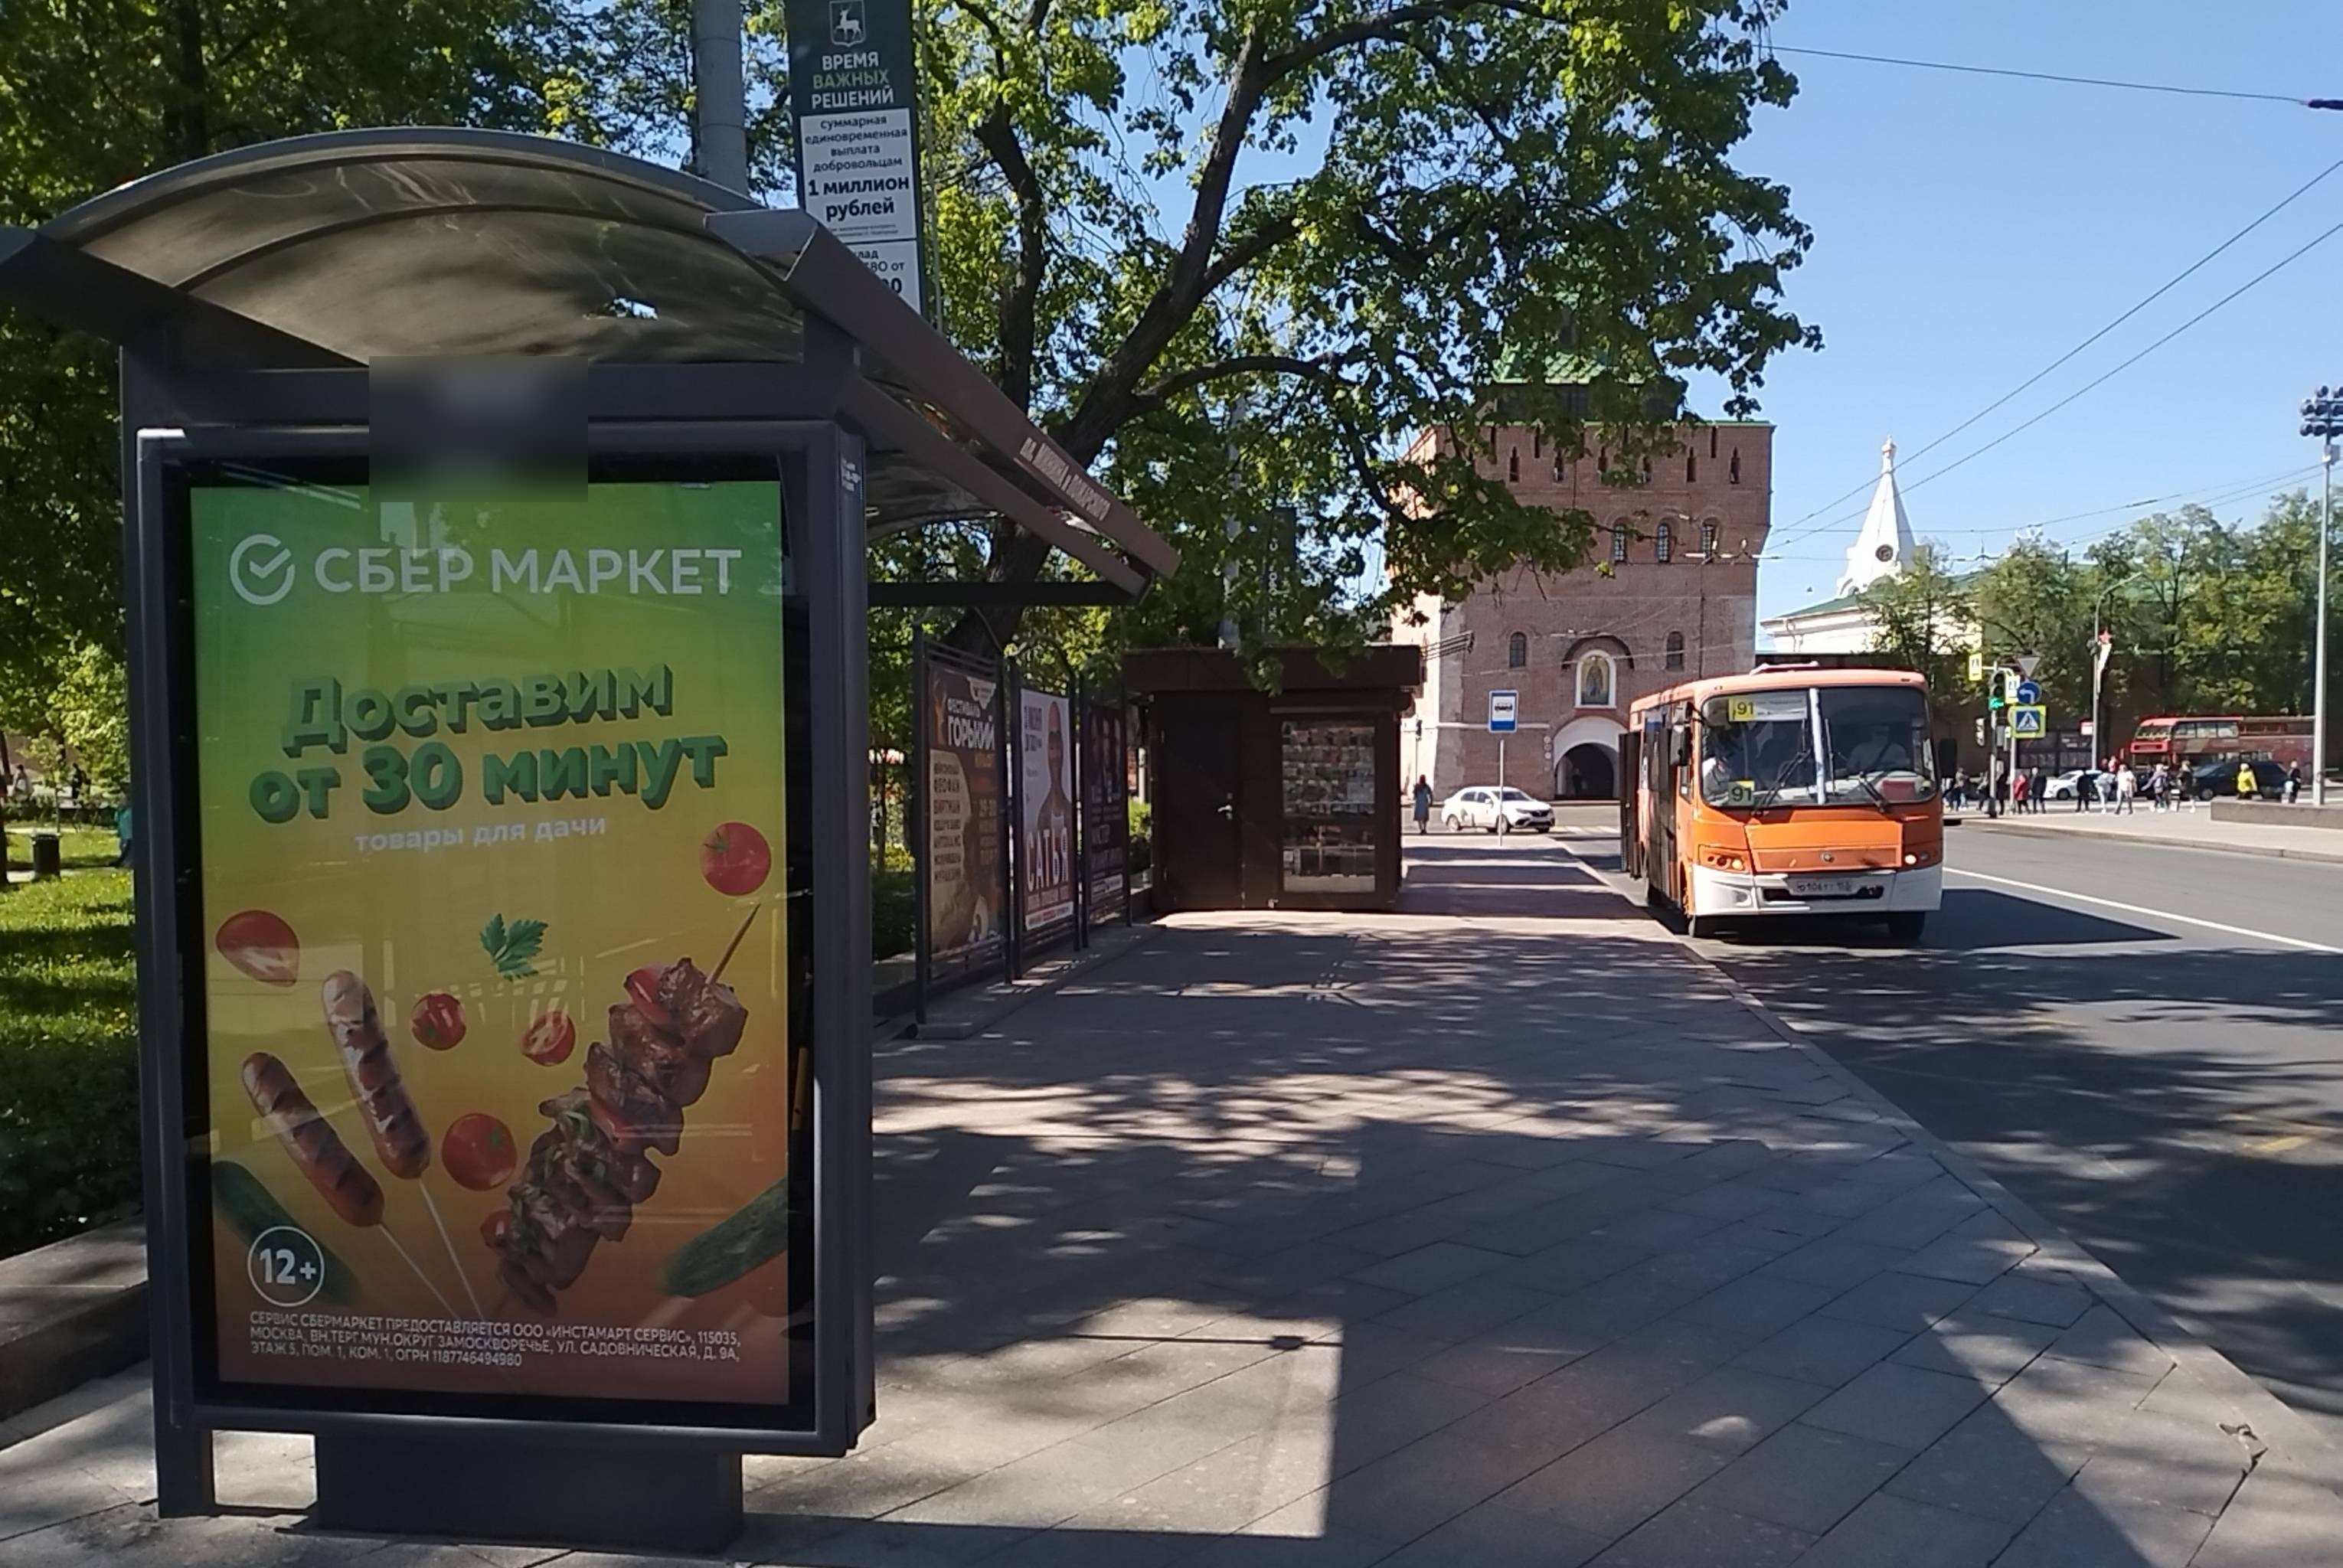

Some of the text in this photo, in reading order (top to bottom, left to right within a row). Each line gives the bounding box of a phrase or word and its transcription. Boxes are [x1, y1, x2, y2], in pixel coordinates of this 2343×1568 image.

[822, 51, 878, 70] ВРЕМЯ
[813, 70, 889, 90] ВАЖНЫХ
[812, 86, 894, 109] РЕШЕНИЙ
[821, 116, 887, 130] суммарная
[805, 129, 907, 145] единовременная
[831, 145, 880, 156] выплата
[813, 158, 903, 173] добровольцам
[809, 177, 909, 196] 1 миллион
[826, 197, 894, 222] рублей
[857, 250, 879, 260] лад
[315, 547, 742, 594] СБЕР МАРКЕТ
[283, 664, 673, 758] Доставим
[1737, 702, 1753, 715] 91
[948, 715, 995, 750] ГОРЬКИЙ
[250, 734, 728, 823] от 30 минут
[1732, 787, 1753, 801] 91
[355, 815, 606, 853] товары для дачи
[1027, 827, 1069, 892] САТЬЯ
[260, 1248, 316, 1284] 12+
[250, 1311, 299, 1326] СЕРВИС
[300, 1314, 383, 1330] СБЕРМАРКЕТ
[385, 1317, 509, 1335] ПРЕДОСТАВЛЯЕТСЯ
[513, 1323, 543, 1338] ООО
[546, 1325, 631, 1341] «ИНСТАМАРТ
[698, 1331, 741, 1348] 115035,
[251, 1341, 286, 1354] ЭТАЖ
[349, 1346, 381, 1360] КОМ.
[395, 1348, 429, 1362] ОГРН
[438, 1335, 554, 1354] ЗАМОСКВОРЕЧЬЕ,
[557, 1341, 577, 1354] УЛ.
[703, 1348, 717, 1360] Д.
